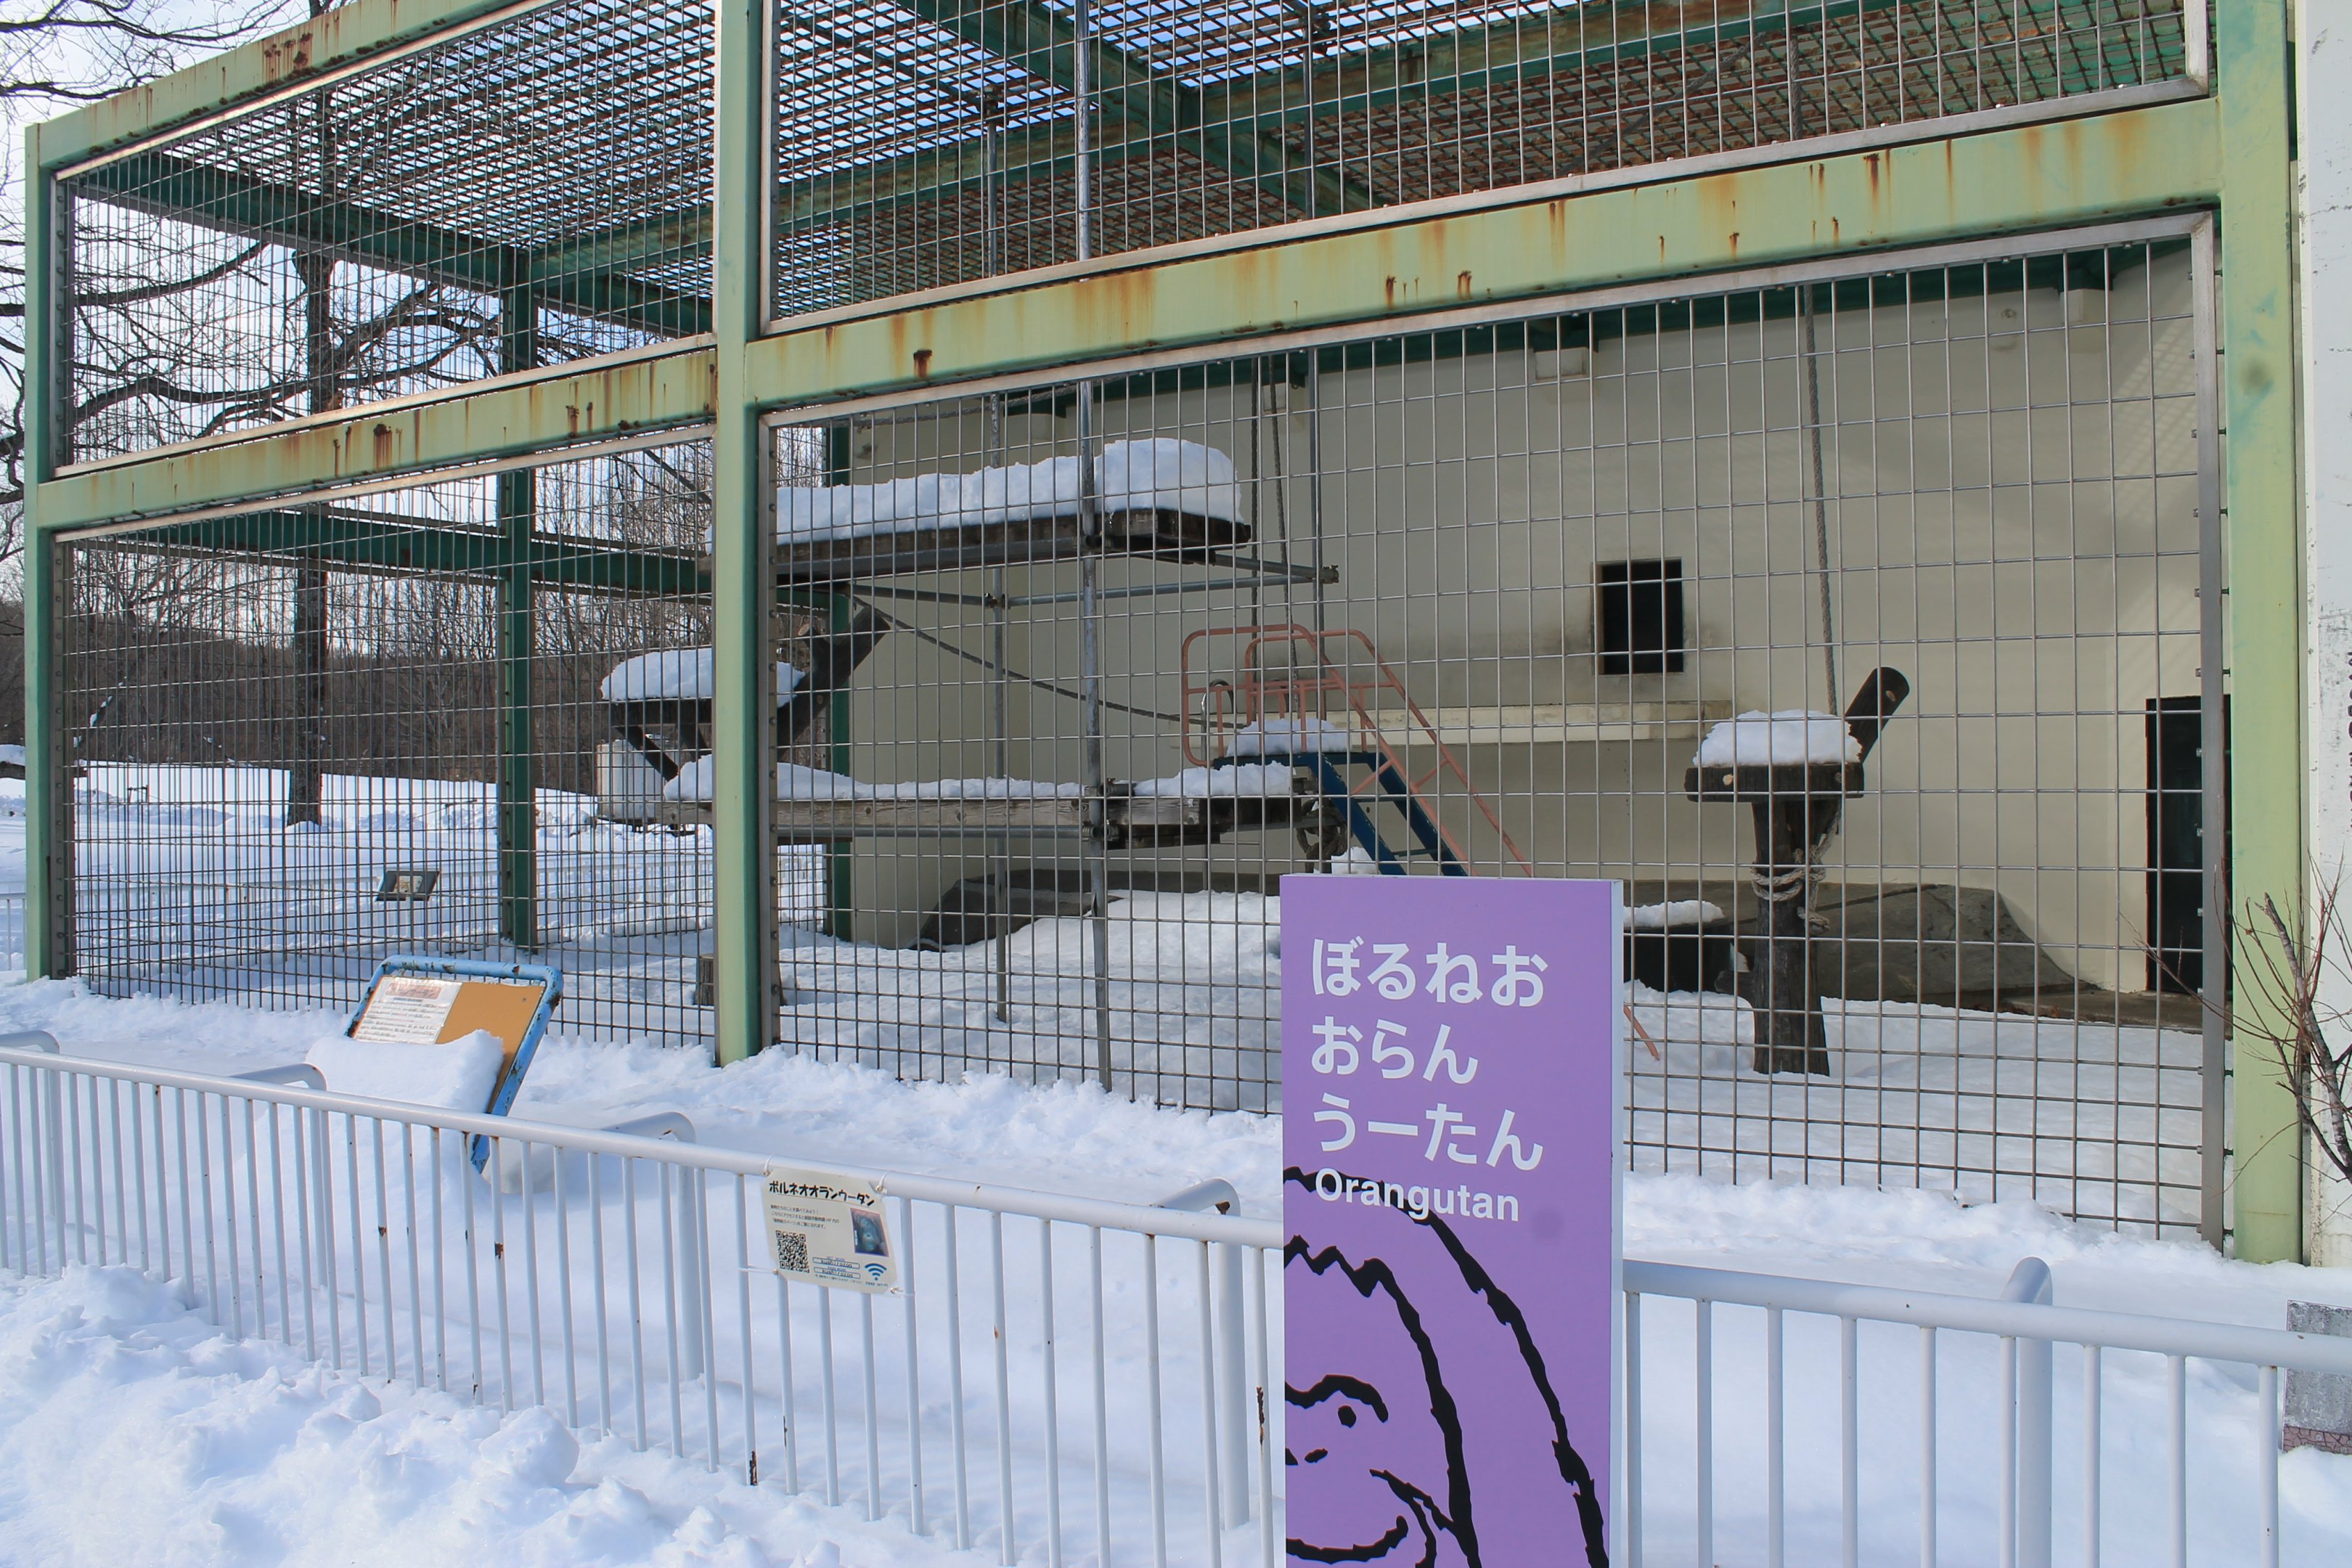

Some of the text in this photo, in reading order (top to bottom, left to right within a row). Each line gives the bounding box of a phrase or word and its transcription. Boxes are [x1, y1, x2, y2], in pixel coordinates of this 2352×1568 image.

[1312, 935, 1548, 1007] ぼるねお
[1311, 1016, 1479, 1084] おらん
[1313, 1092, 1543, 1171] うーたん
[769, 1180, 875, 1206] ボルネオオランウータン
[1315, 1167, 1519, 1222] Orangutan
